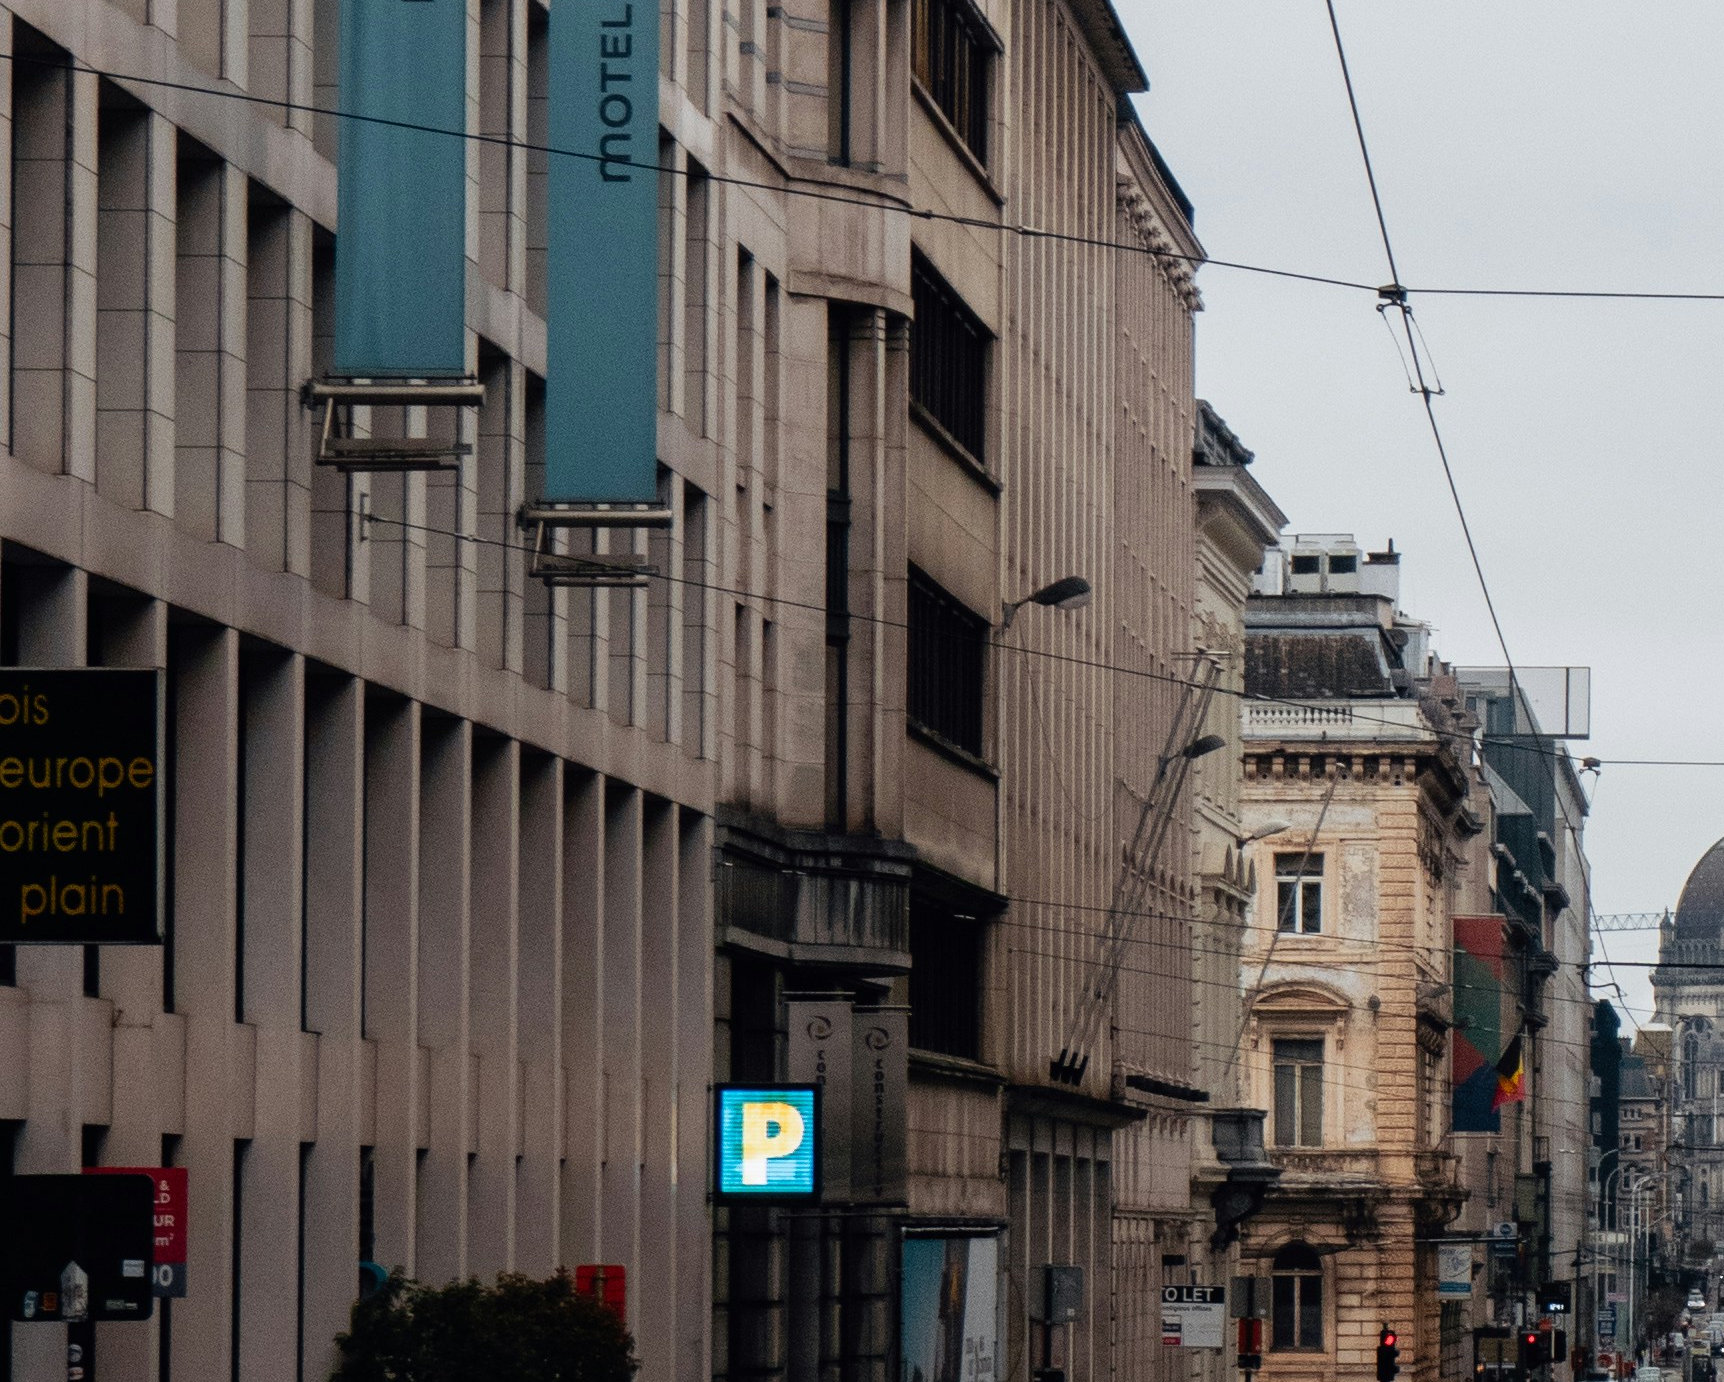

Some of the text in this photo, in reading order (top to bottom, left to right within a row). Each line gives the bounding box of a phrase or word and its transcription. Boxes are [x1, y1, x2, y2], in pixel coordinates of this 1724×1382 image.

[0, 756, 154, 797] europe
[0, 811, 119, 852] orient
[21, 874, 125, 924] plain
[741, 1101, 805, 1186] P
[1183, 1288, 1215, 1302] LET
